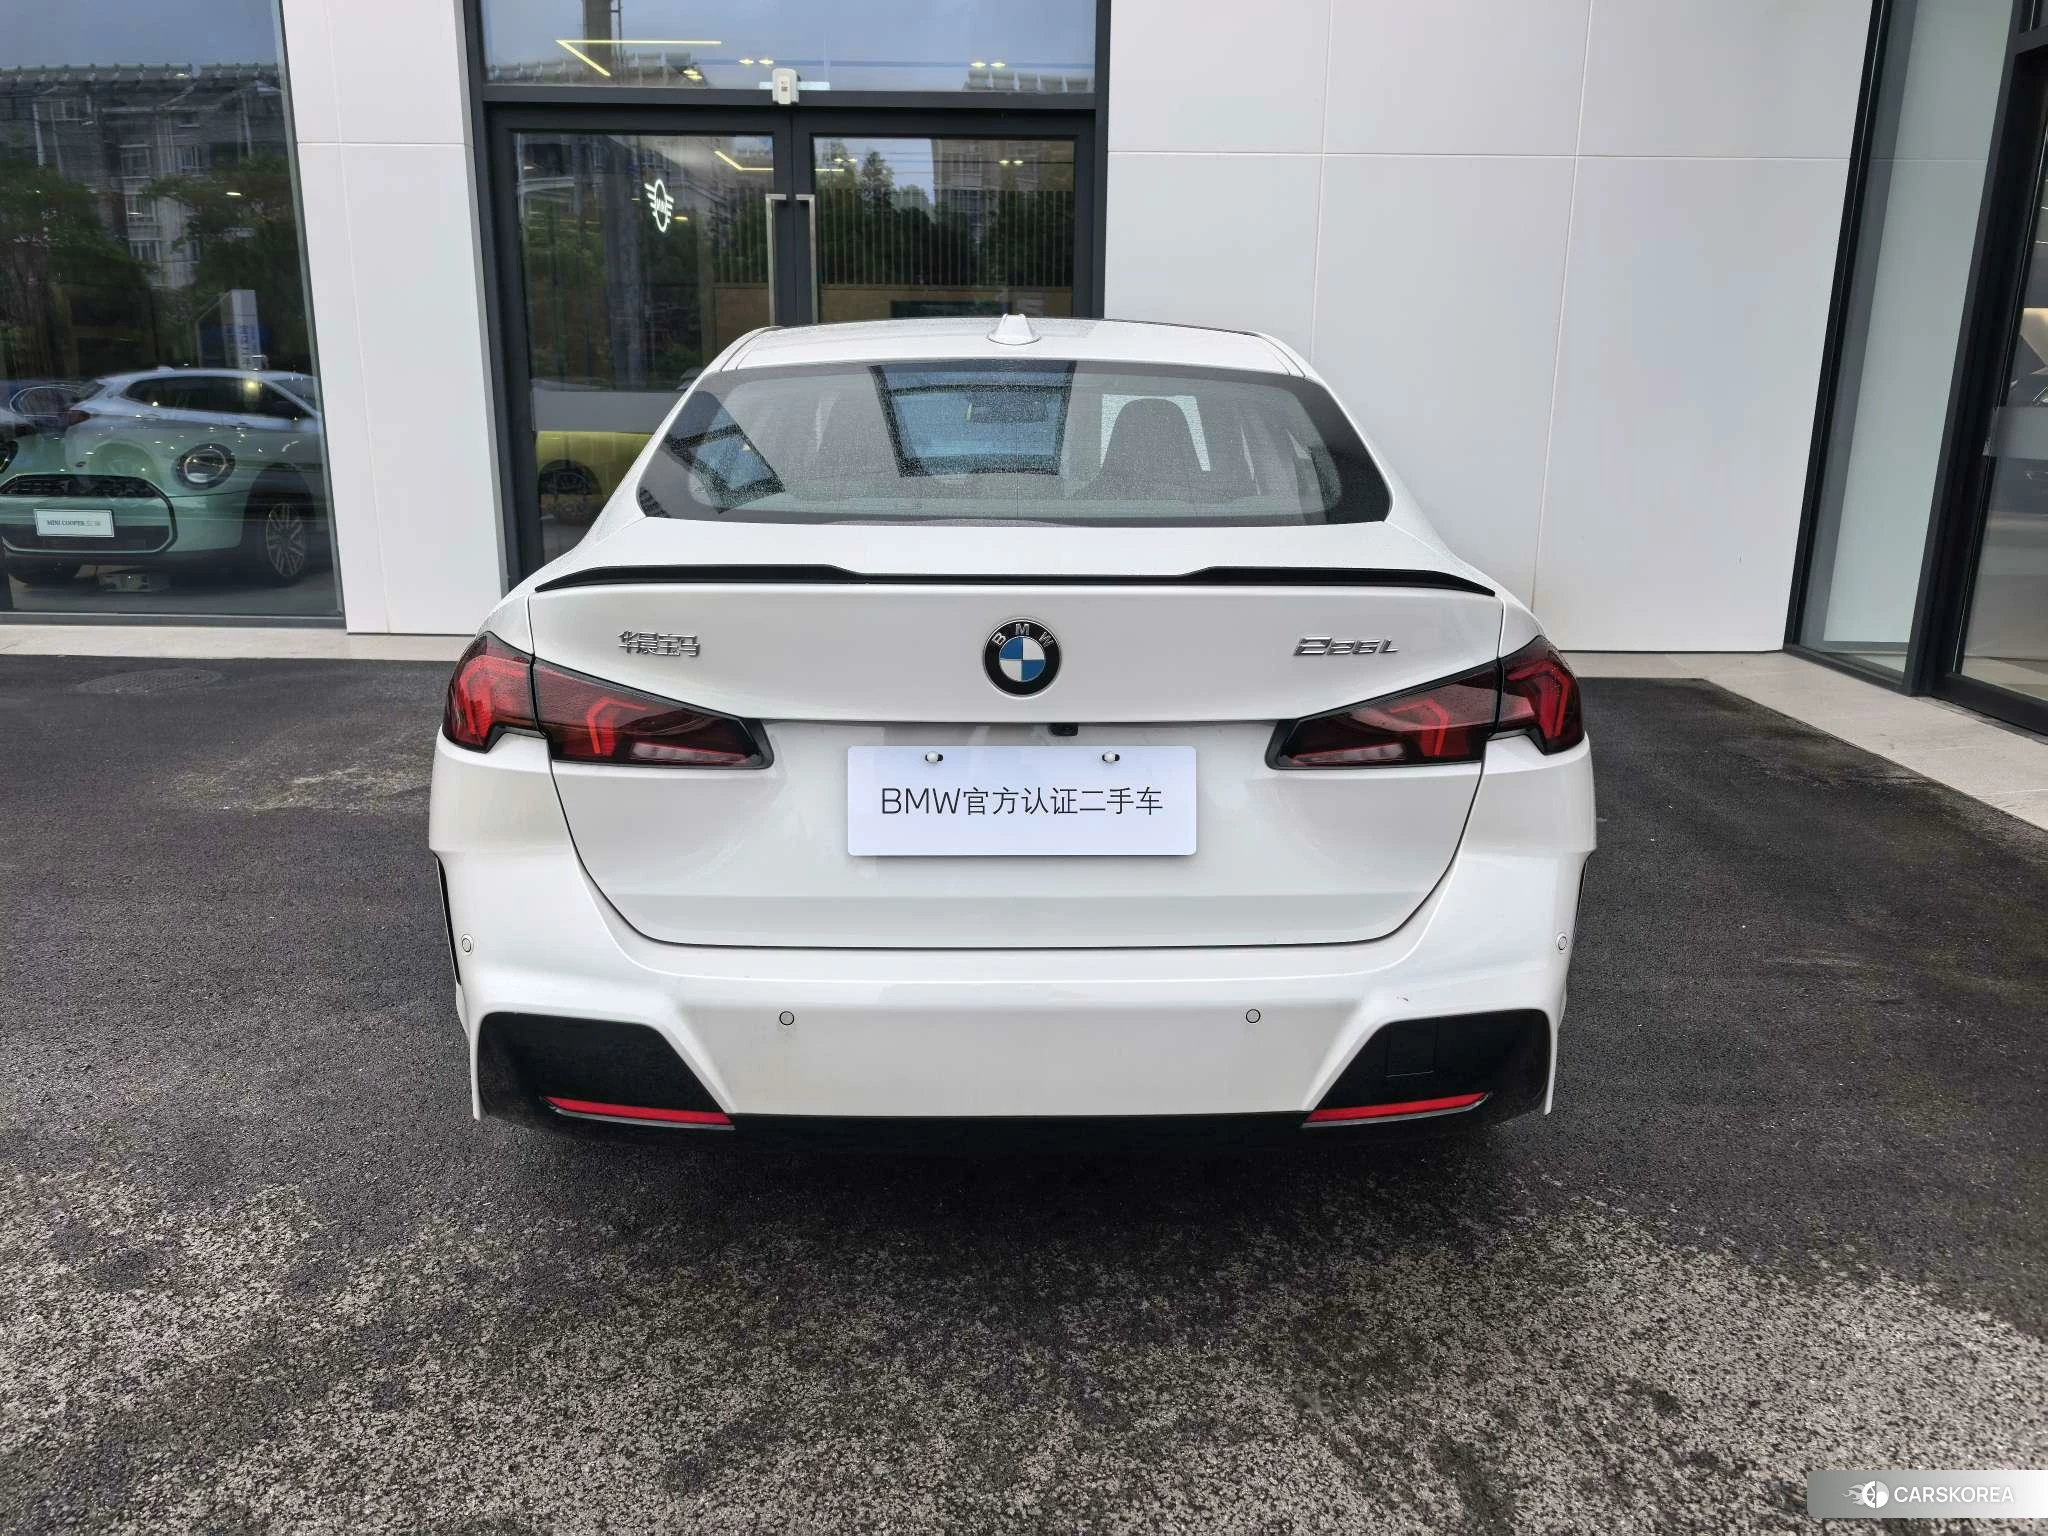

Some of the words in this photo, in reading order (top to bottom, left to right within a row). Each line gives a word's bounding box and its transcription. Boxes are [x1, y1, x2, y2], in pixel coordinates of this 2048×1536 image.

[991, 623, 1055, 648] BMW
[881, 786, 1164, 816] BMW官方认证二手车
